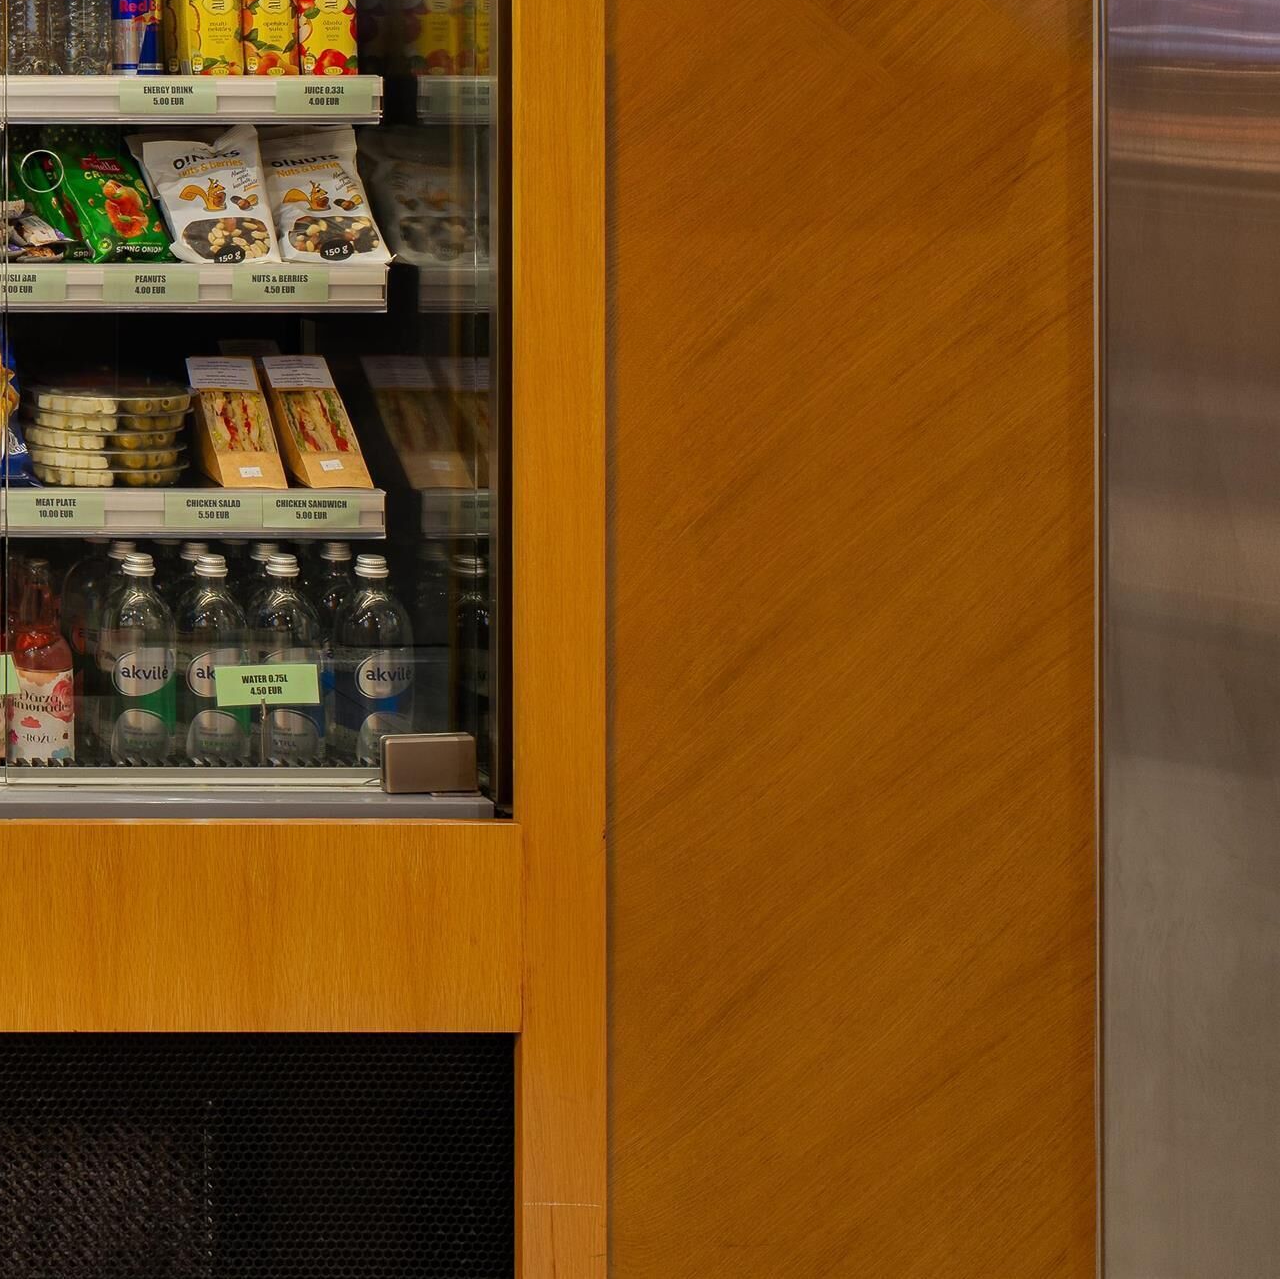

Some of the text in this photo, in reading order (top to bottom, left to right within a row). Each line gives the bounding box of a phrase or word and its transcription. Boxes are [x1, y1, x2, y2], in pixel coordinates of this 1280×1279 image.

[119, 0, 147, 13] Red
[143, 86, 193, 94] ENERGY DRINK
[304, 86, 344, 94] JUICE 0.33L
[153, 97, 184, 105] 5.00 EUR
[308, 97, 340, 105] 4.00 EUR
[209, 159, 243, 171] berries
[324, 247, 341, 256] 150
[22, 274, 37, 282] BAR
[135, 275, 166, 283] PEANUTS
[252, 274, 308, 283] NUTS & BERRIES
[19, 286, 33, 294] EUR
[135, 286, 166, 294] 4.00 EUR
[264, 286, 295, 294] 4.50 EUR
[35, 498, 76, 507] MEAT PLATE
[186, 499, 241, 508] CHICKEN SALAD
[276, 499, 347, 508] CHICKEN SANDWICH
[39, 509, 74, 518] 10.00 EUR
[198, 511, 229, 519] 5.50 EUR
[296, 511, 327, 520] 5.00 EUR
[121, 666, 169, 681] akvilė
[365, 666, 412, 682] akvilė
[241, 674, 289, 684] WATER 0.75L
[250, 685, 282, 695] 4.50 EUR
